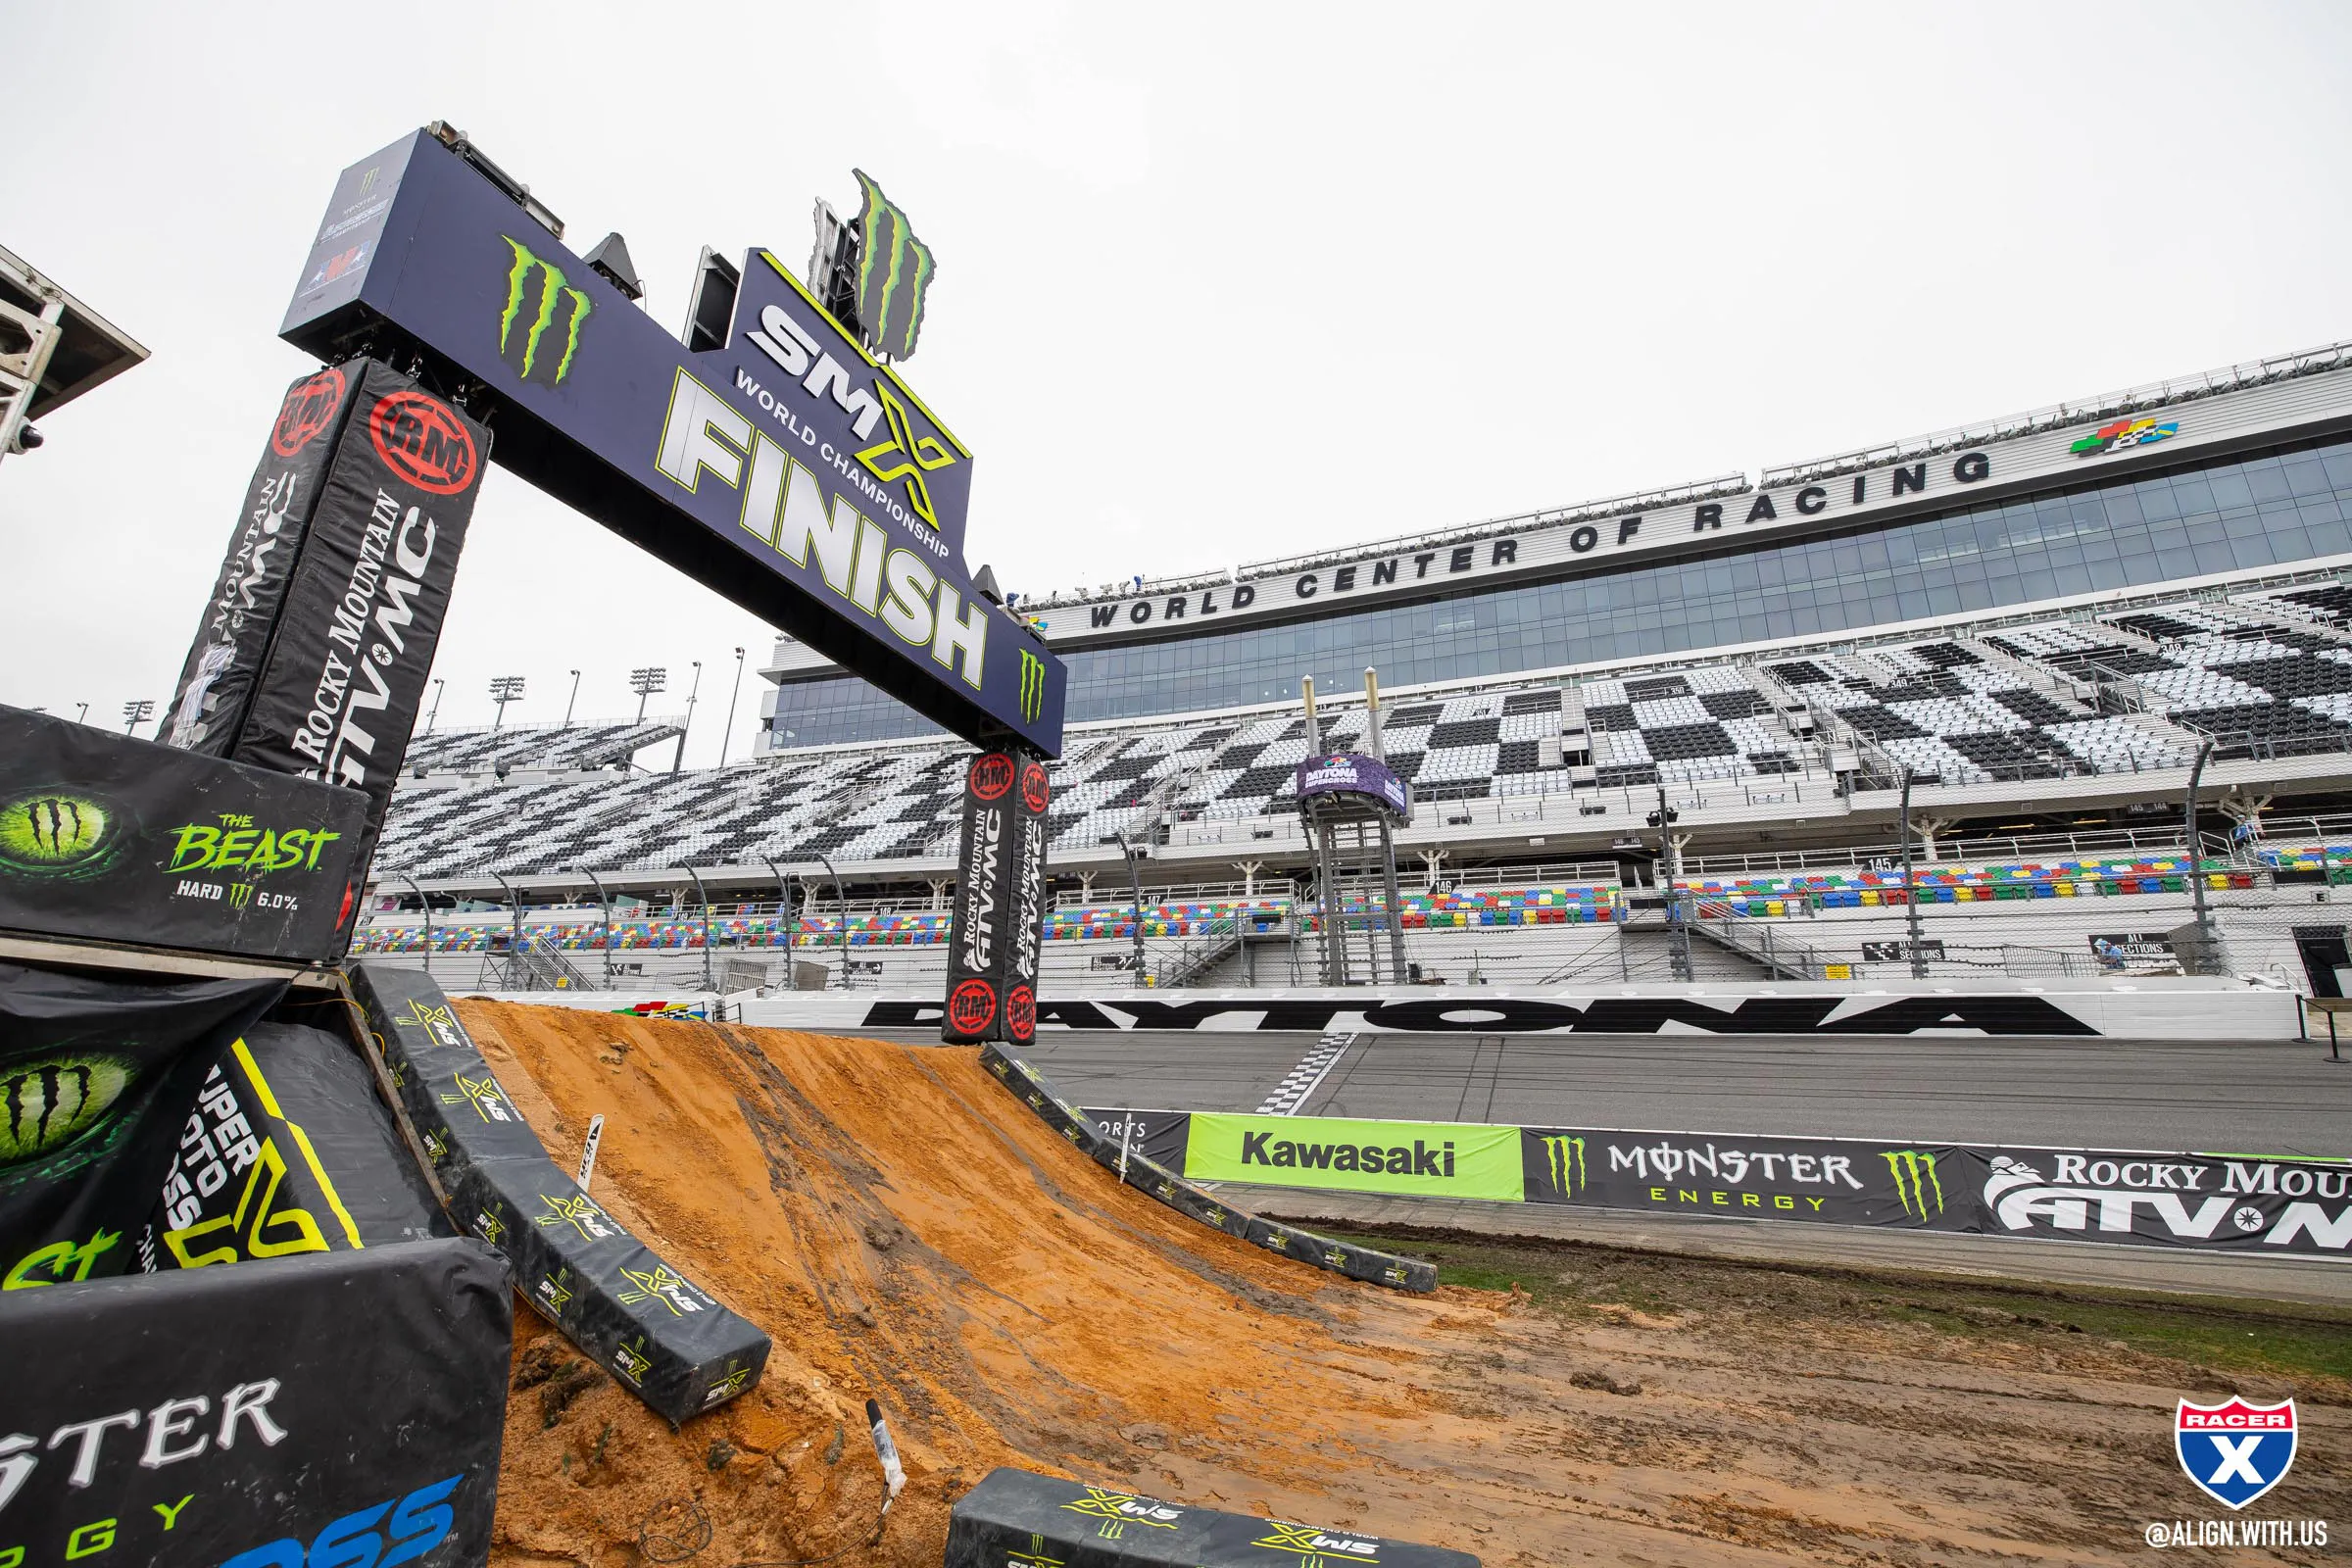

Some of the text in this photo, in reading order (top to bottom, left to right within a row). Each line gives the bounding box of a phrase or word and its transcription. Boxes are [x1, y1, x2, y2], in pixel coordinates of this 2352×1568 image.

[746, 305, 956, 532] SMX
[735, 368, 950, 560] WORLD CHAMPIONSHIP
[655, 366, 989, 690] FINISH
[1091, 452, 1990, 628] WORLD CENTER OF RACING
[211, 475, 276, 633] MOUNTAIN
[292, 487, 402, 764] ROCKY MOUNTAIN
[1891, 679, 1908, 688] 349
[1304, 777, 1358, 789] SUPERCROSS
[1305, 767, 1358, 782] DAYTONA
[218, 813, 256, 828] THE
[162, 825, 342, 874] BEAST
[1868, 858, 1892, 872] 145
[964, 808, 986, 944] ROCKY MOUNTAIN
[1017, 816, 1033, 954] ROCKY MOUNTAIN
[1435, 881, 1452, 894] 146
[176, 879, 298, 910] HARD 6.0%
[1148, 896, 1161, 906] 147
[1899, 949, 1941, 959] SECIONS
[416, 1003, 461, 1047] SMX
[858, 996, 2105, 1036] DAYTONA
[462, 1075, 512, 1122] SMX
[1242, 1131, 1455, 1177] Kawasaki
[1607, 1142, 1864, 1190] MONSTER
[2052, 1154, 2352, 1199] ROCKY MOU
[549, 1196, 614, 1237] SMX
[1650, 1187, 1827, 1212] ENERGY
[477, 1214, 505, 1244] SMX
[539, 1280, 569, 1313] SMX
[630, 1266, 705, 1312] SMX
[615, 1350, 651, 1383] SMX
[706, 1373, 746, 1401] SMX
[1070, 1488, 1184, 1520] SMX
[1259, 1522, 1380, 1554] SMX
[1264, 1518, 1334, 1533] CHAMPIONSHIP
